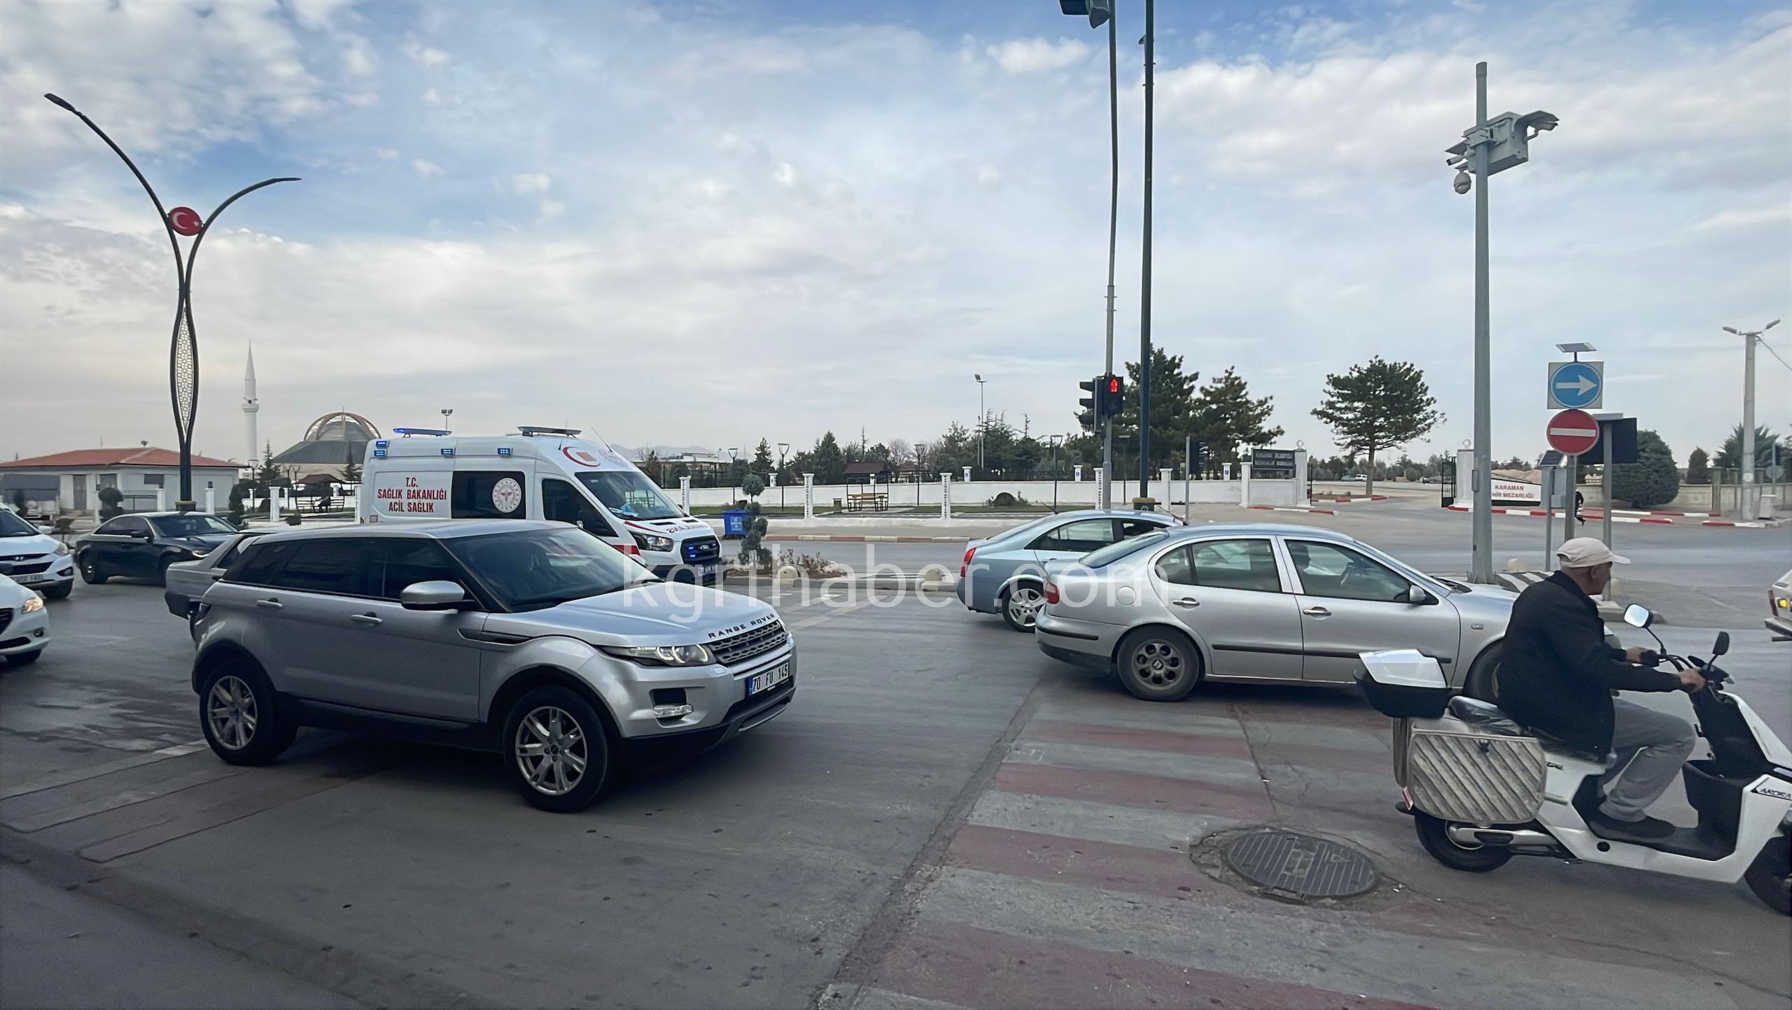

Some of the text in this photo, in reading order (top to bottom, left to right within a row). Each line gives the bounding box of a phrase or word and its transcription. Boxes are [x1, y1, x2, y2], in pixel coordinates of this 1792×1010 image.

[405, 476, 419, 488] T.C.
[406, 488, 447, 501] BAKANLIĞI
[388, 500, 405, 513] ACİL
[708, 614, 775, 639] RANGE ROVER
